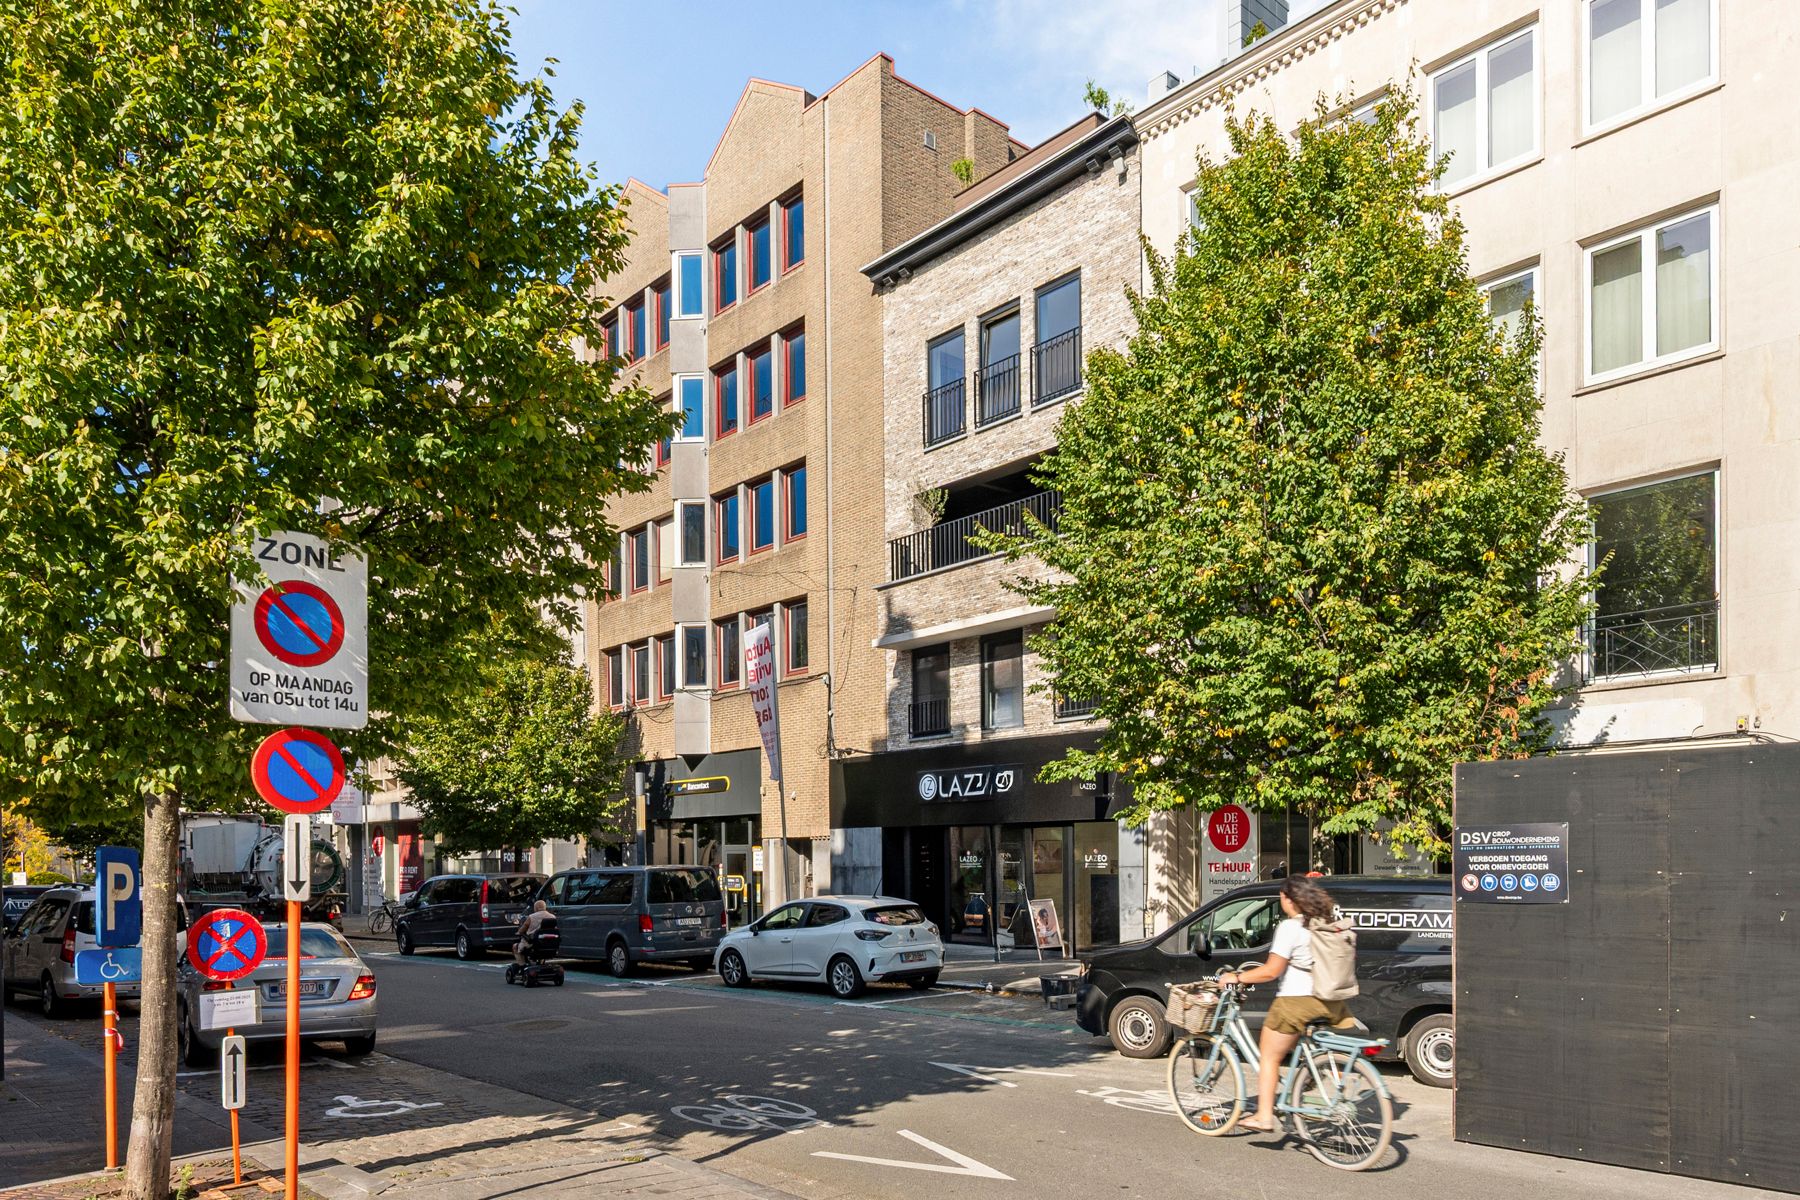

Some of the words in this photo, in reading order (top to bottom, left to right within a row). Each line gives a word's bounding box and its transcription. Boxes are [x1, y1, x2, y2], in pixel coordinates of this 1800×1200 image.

[258, 537, 346, 572] ZONE
[250, 672, 270, 687] OP
[276, 673, 353, 695] MAANDAG
[242, 690, 269, 704] van
[274, 691, 304, 708] 05u
[309, 694, 330, 709] tot
[335, 697, 358, 712] 14u
[1224, 812, 1238, 823] DE
[1216, 824, 1238, 834] WAE
[1225, 835, 1238, 845] LE
[1460, 832, 1491, 844] DSV
[504, 852, 515, 862] FOR
[1208, 863, 1220, 872] TE
[1222, 863, 1251, 872] HUUR
[107, 862, 134, 930] P
[1346, 912, 1453, 928] TOPORAM
